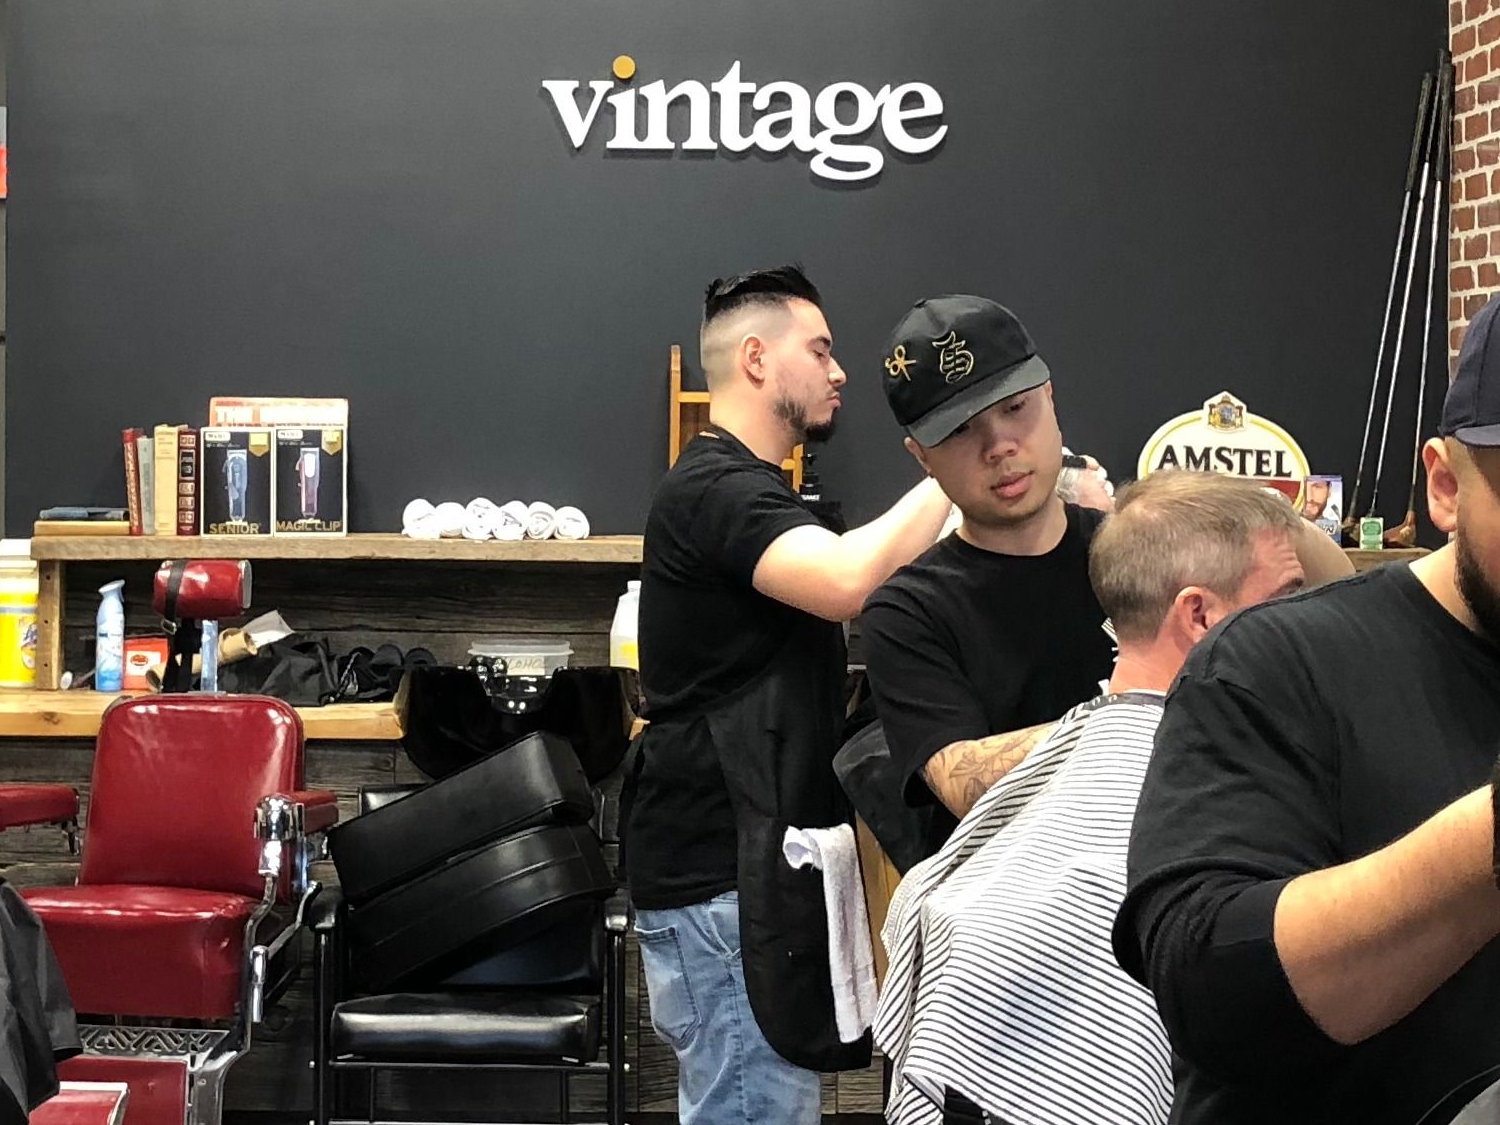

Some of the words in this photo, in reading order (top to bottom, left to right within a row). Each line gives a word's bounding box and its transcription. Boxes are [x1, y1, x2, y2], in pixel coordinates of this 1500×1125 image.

[542, 55, 948, 181] vintage
[1156, 444, 1292, 477] AMSTEL
[209, 523, 260, 534] SENIOR
[276, 521, 313, 531] MAGIC
[315, 521, 341, 531] CLIP
